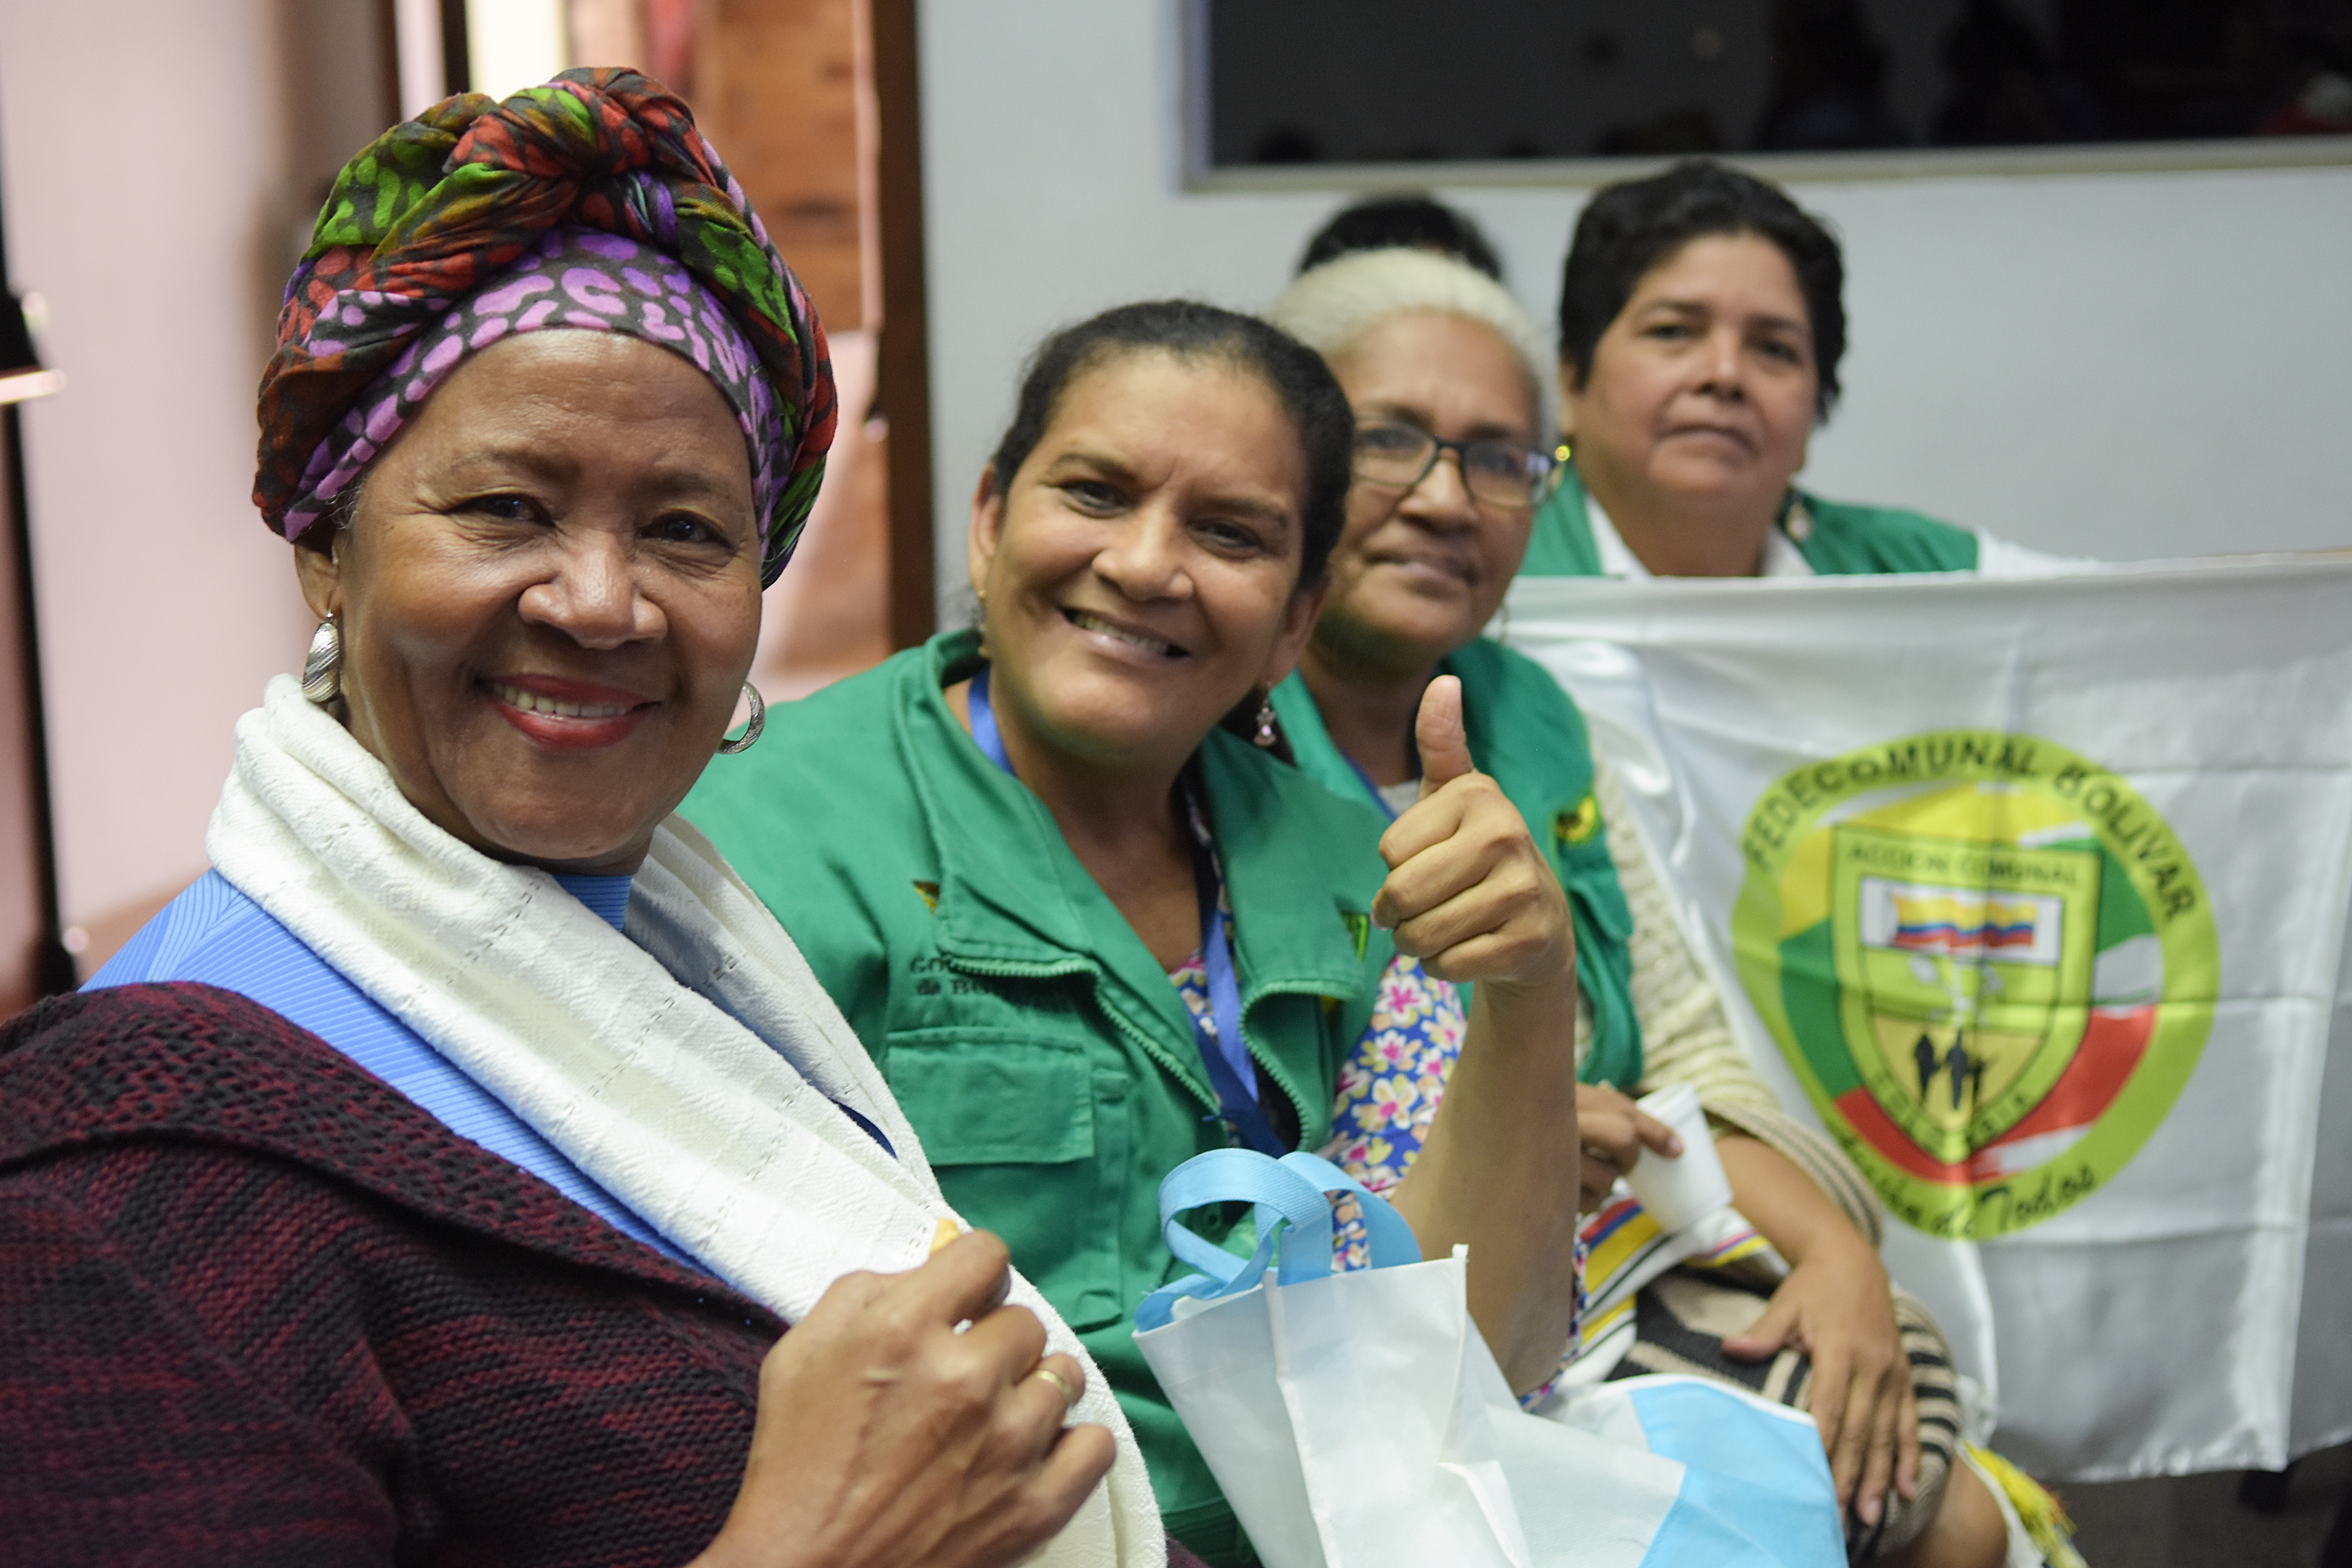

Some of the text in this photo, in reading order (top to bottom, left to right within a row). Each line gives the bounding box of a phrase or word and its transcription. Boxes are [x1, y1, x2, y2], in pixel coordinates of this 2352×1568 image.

[1742, 737, 2197, 922] FEDECOMUNAL BOLIVAR
[1976, 1162, 2096, 1233] Todos
